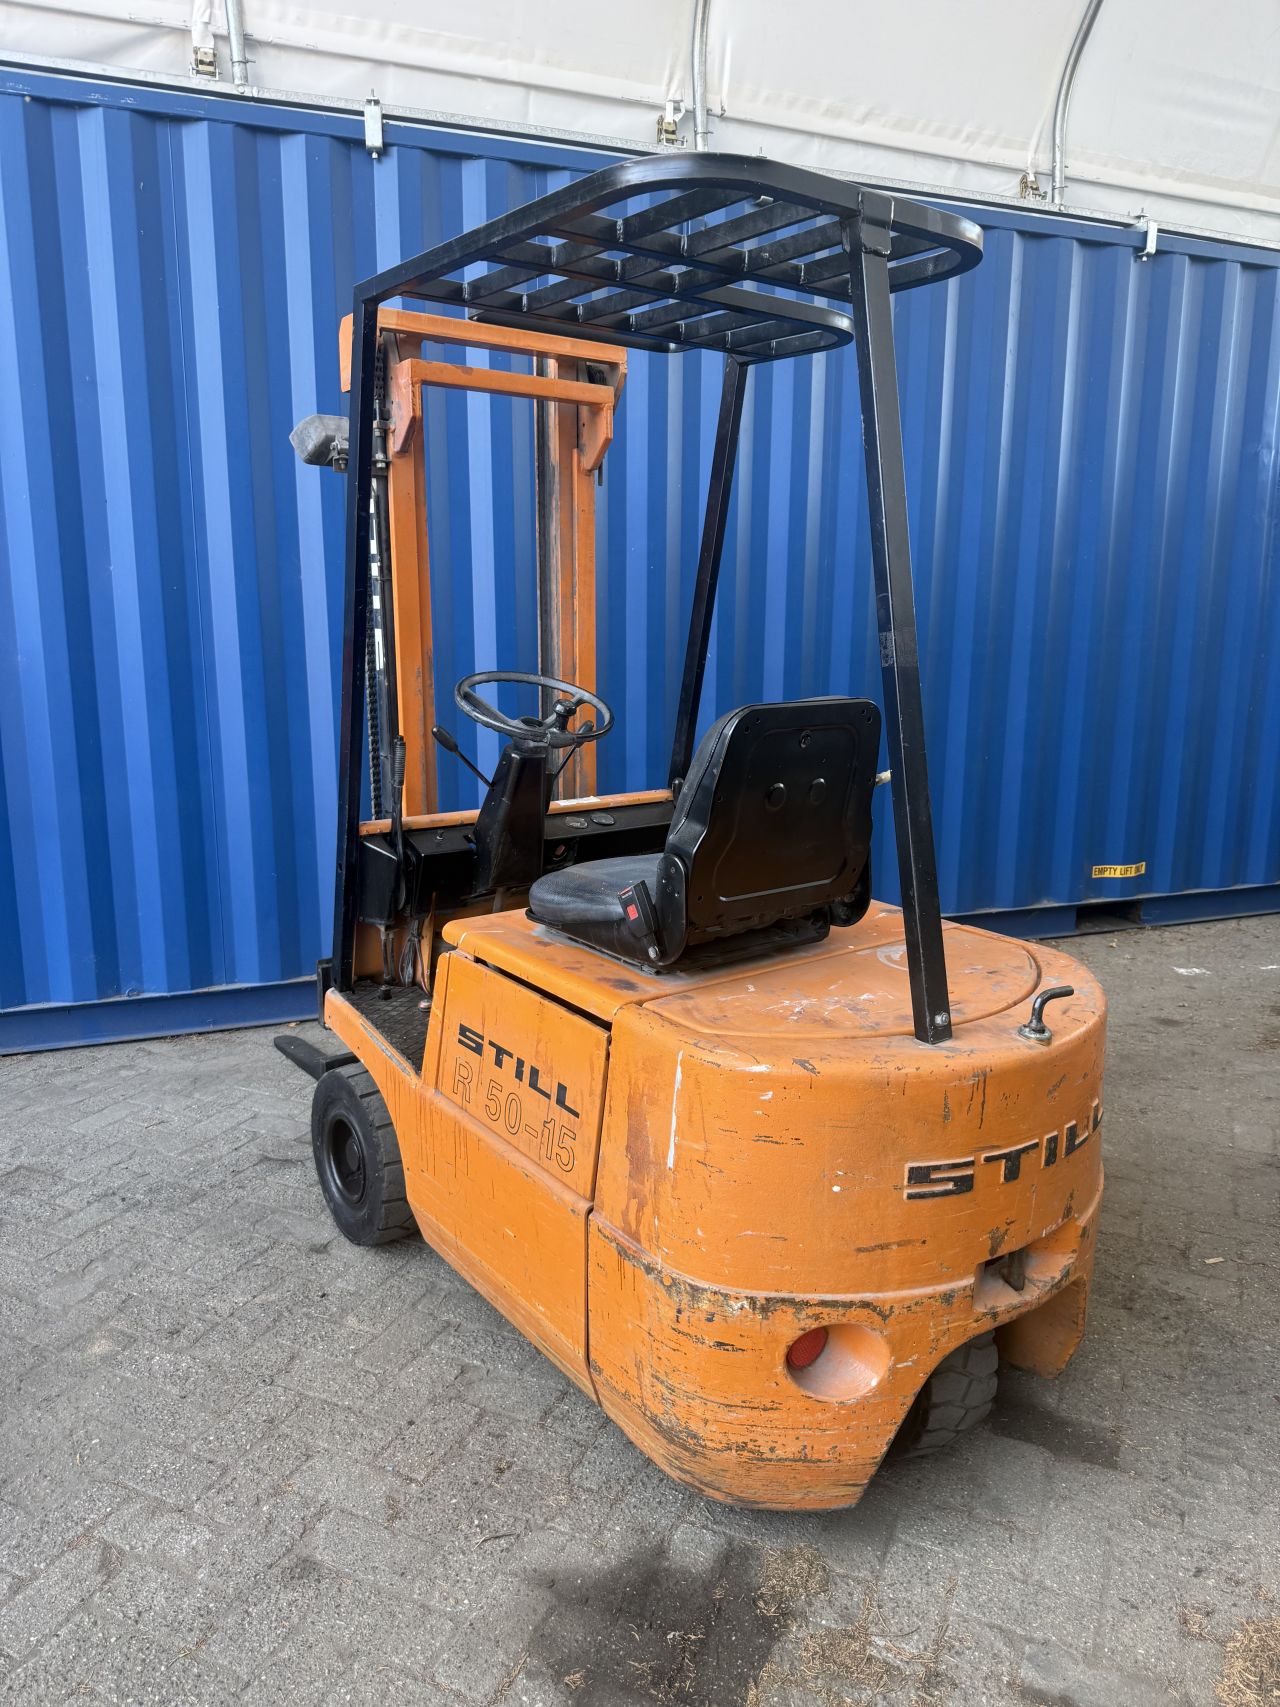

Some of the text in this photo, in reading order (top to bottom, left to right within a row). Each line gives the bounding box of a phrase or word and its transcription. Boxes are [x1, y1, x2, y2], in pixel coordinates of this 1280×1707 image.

[1093, 866, 1118, 876] EMPTY
[1119, 866, 1133, 876] LIFT
[452, 1056, 577, 1173] R 50-15
[457, 1022, 580, 1120] STILL
[903, 1098, 1104, 1201] STILL
